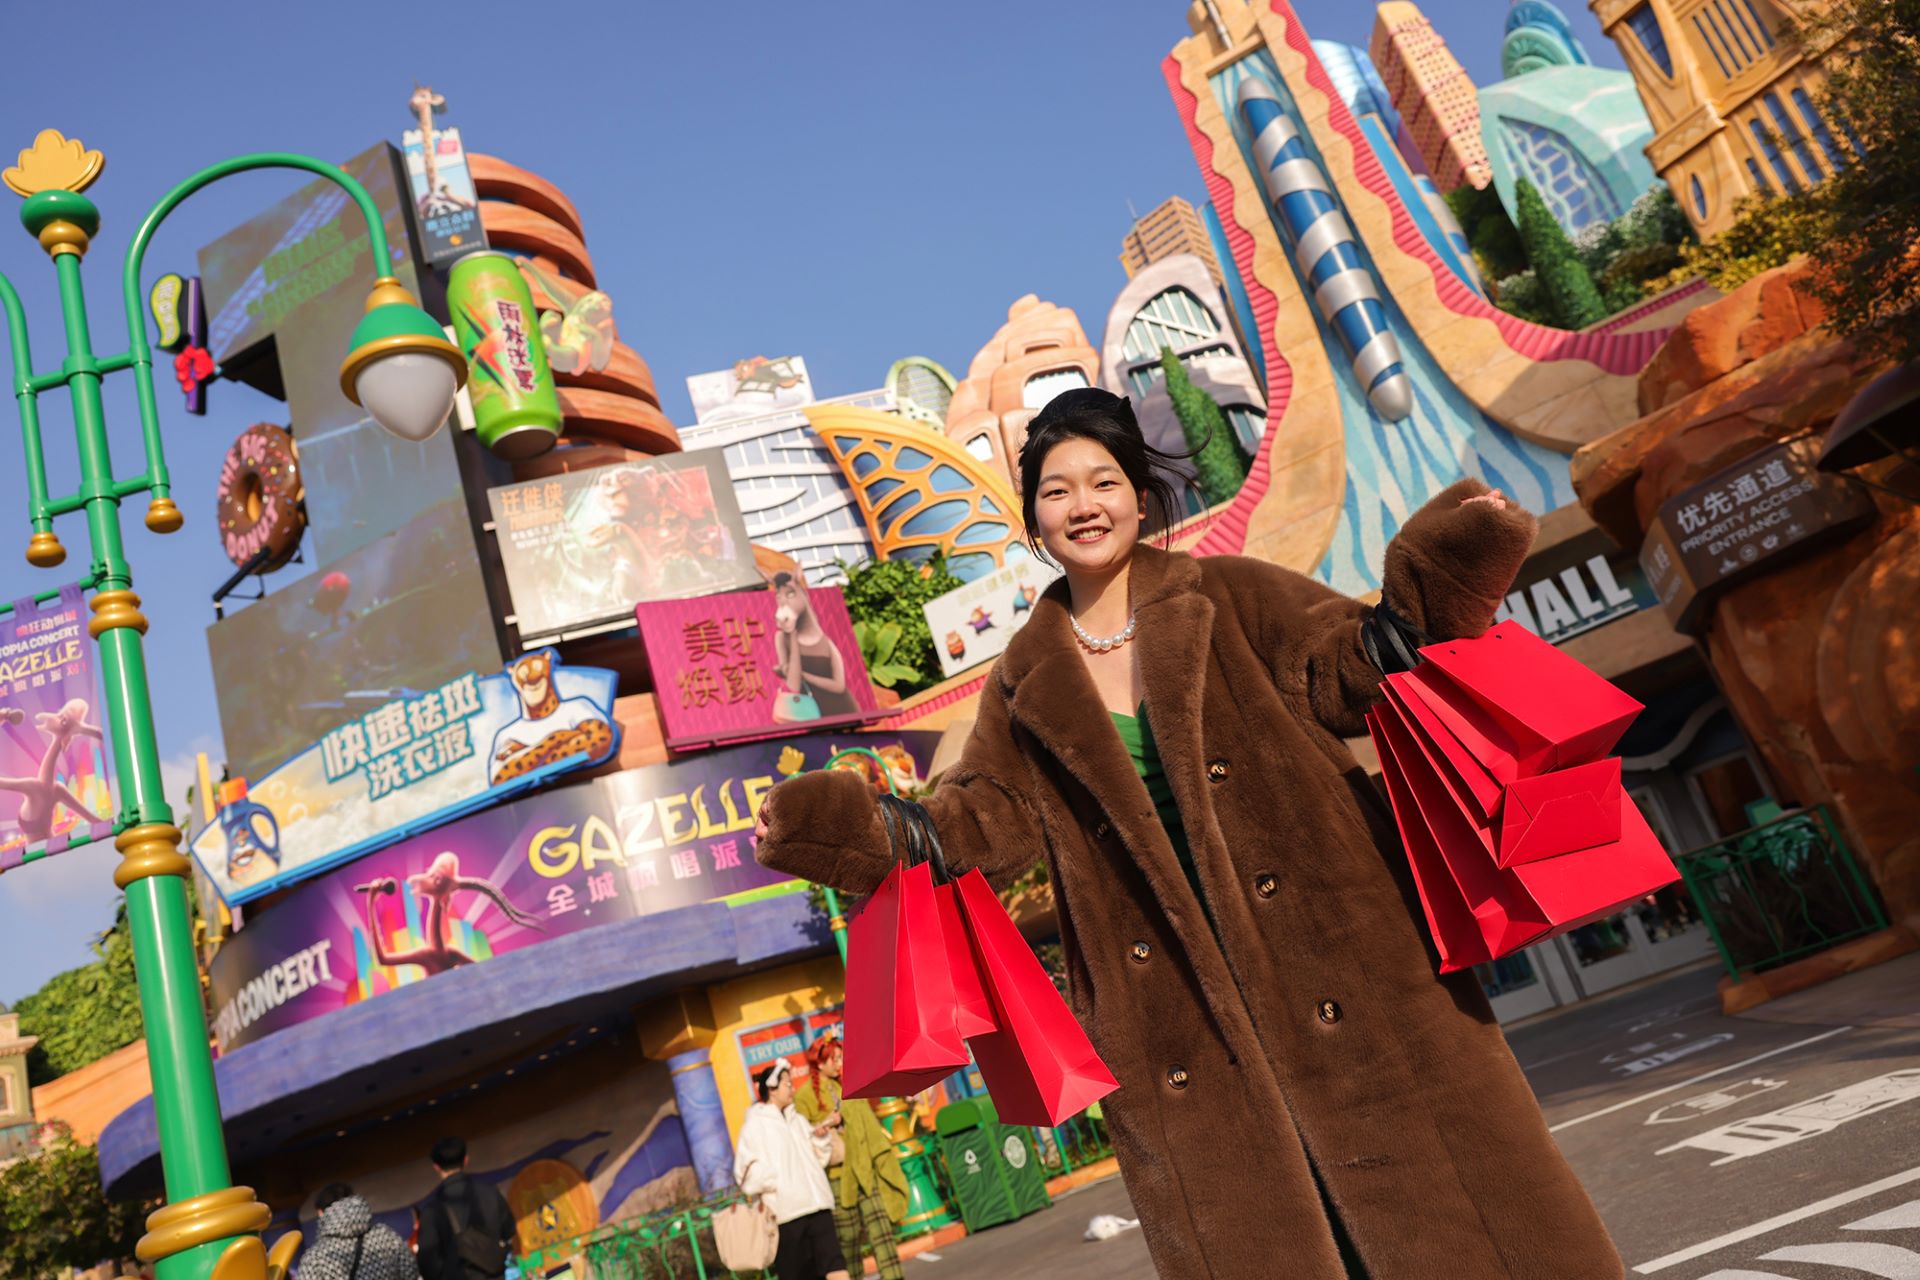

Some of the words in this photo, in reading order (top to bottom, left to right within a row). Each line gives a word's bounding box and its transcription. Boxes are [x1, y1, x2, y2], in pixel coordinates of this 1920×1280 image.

[1677, 459, 1793, 534] 优先通道
[1680, 512, 1745, 553] PRIORITY
[1750, 480, 1814, 517] ACCESS
[1708, 507, 1792, 556] ENTRANCE
[29, 624, 80, 649] CONCERT
[320, 672, 483, 781] 快速祛斑
[367, 720, 473, 799] 洗衣液
[528, 776, 775, 878] GAZELLE
[237, 938, 332, 1028] CONCERT
[749, 1044, 773, 1061] TRY
[775, 1036, 801, 1054] OUR
